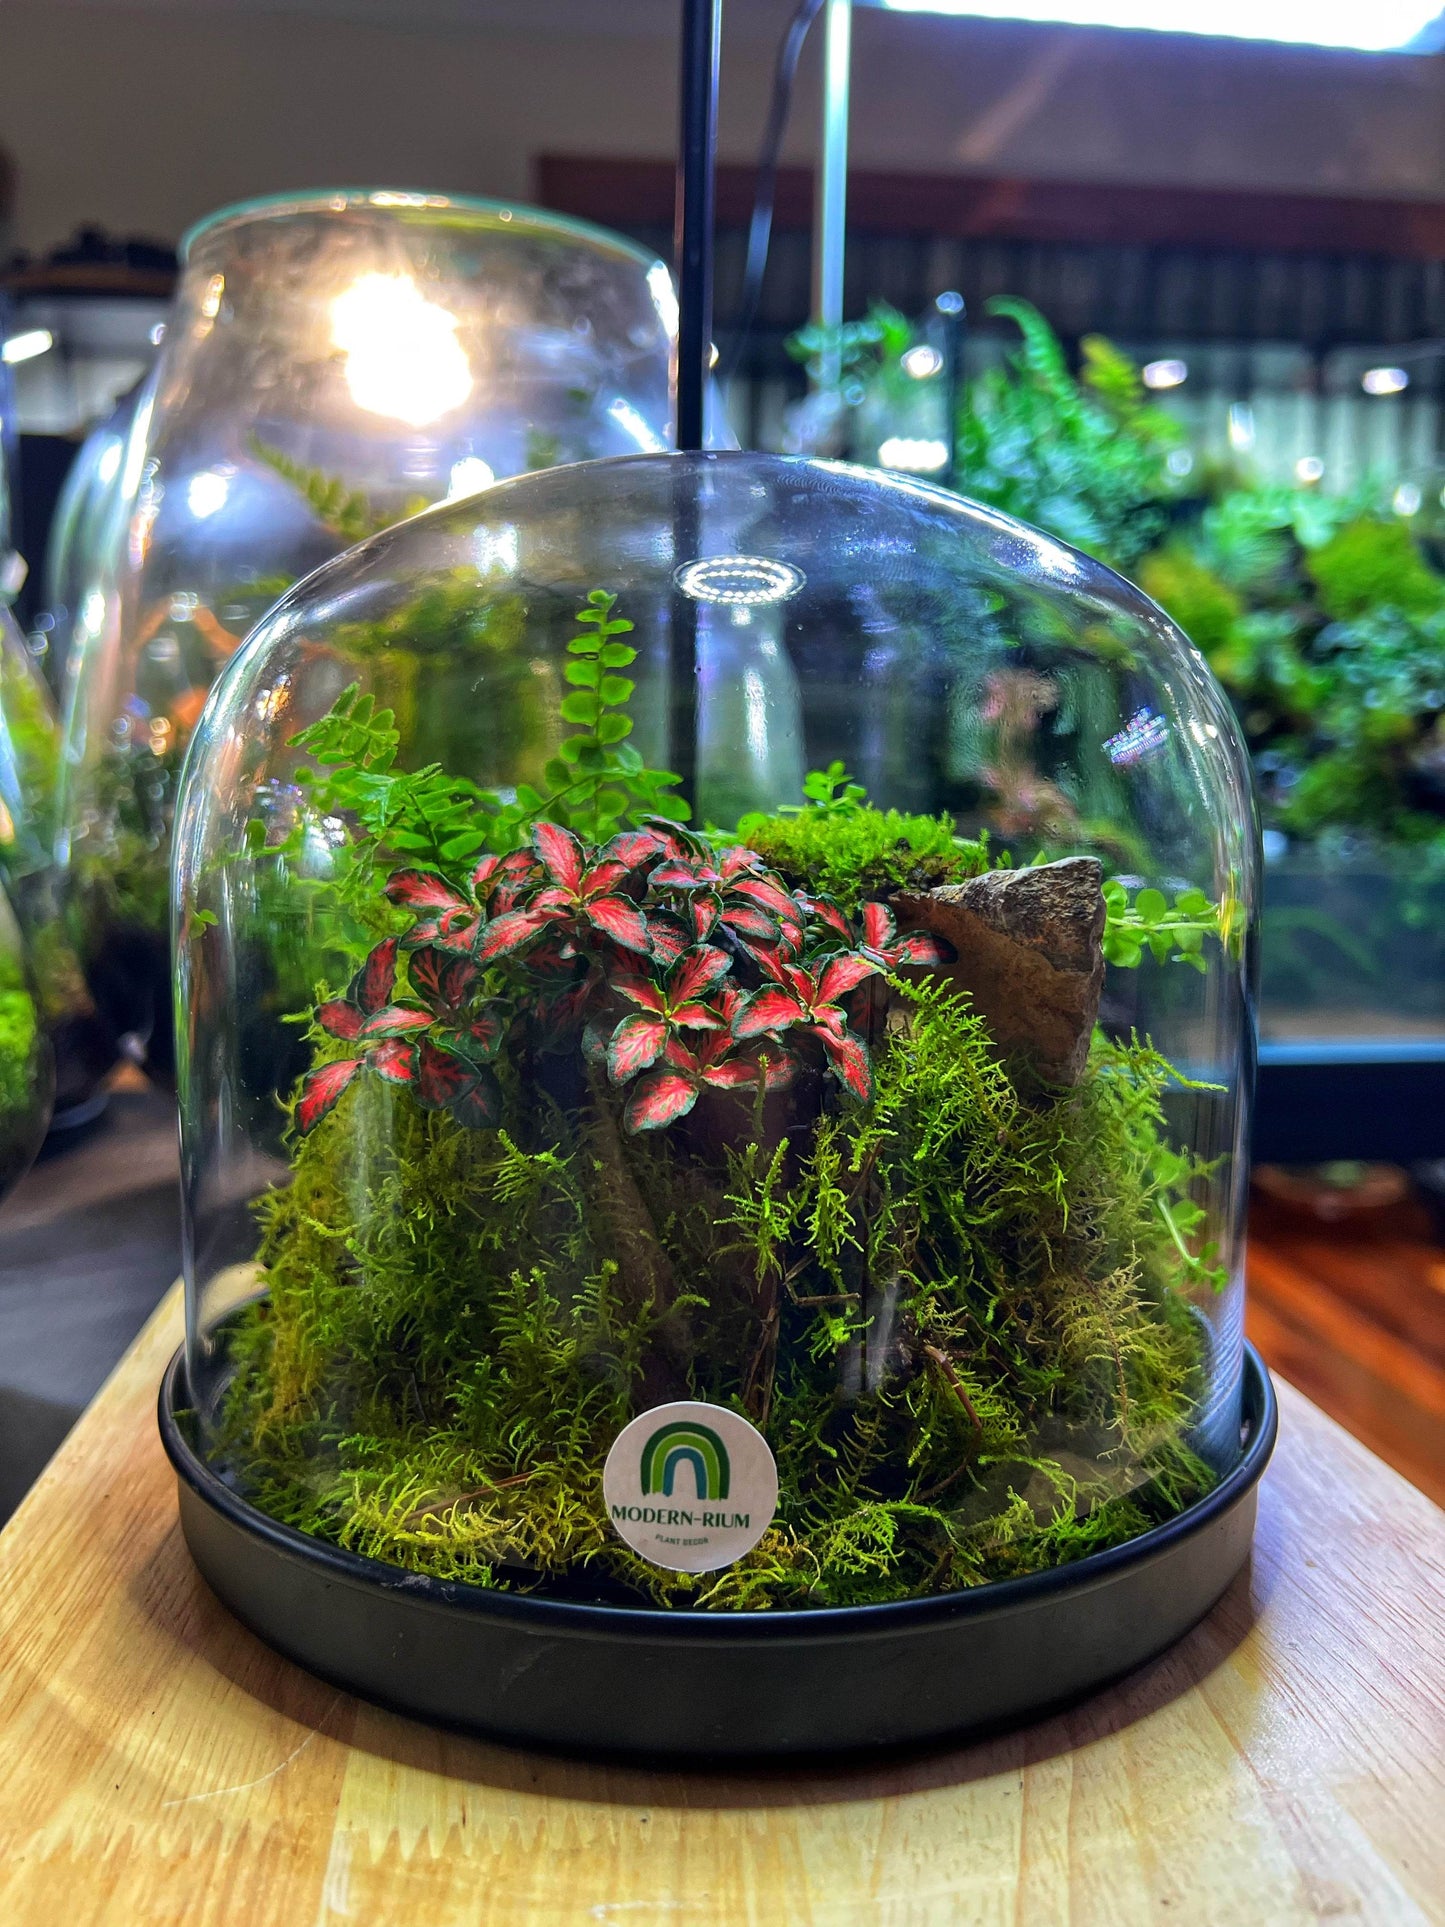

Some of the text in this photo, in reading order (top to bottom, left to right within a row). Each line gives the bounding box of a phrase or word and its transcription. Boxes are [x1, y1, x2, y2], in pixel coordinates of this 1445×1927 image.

[611, 1505, 750, 1529] MODERN-RIUM
[655, 1533, 709, 1546] PLANT DECOR
